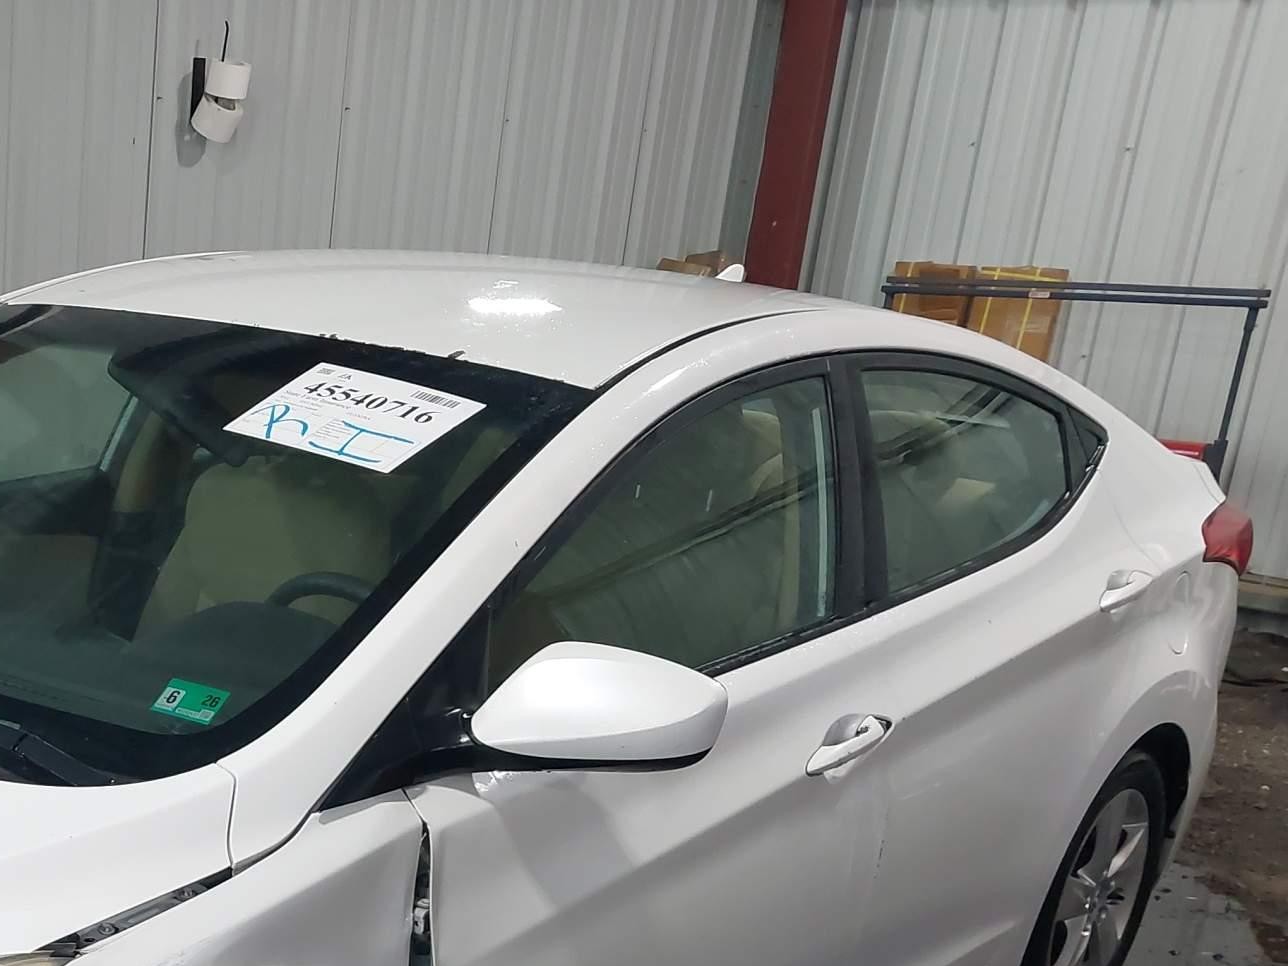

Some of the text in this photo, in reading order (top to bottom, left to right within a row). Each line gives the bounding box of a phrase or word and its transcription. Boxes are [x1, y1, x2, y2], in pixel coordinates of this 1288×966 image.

[303, 382, 441, 424] 45540716
[166, 690, 221, 708] 6 26
